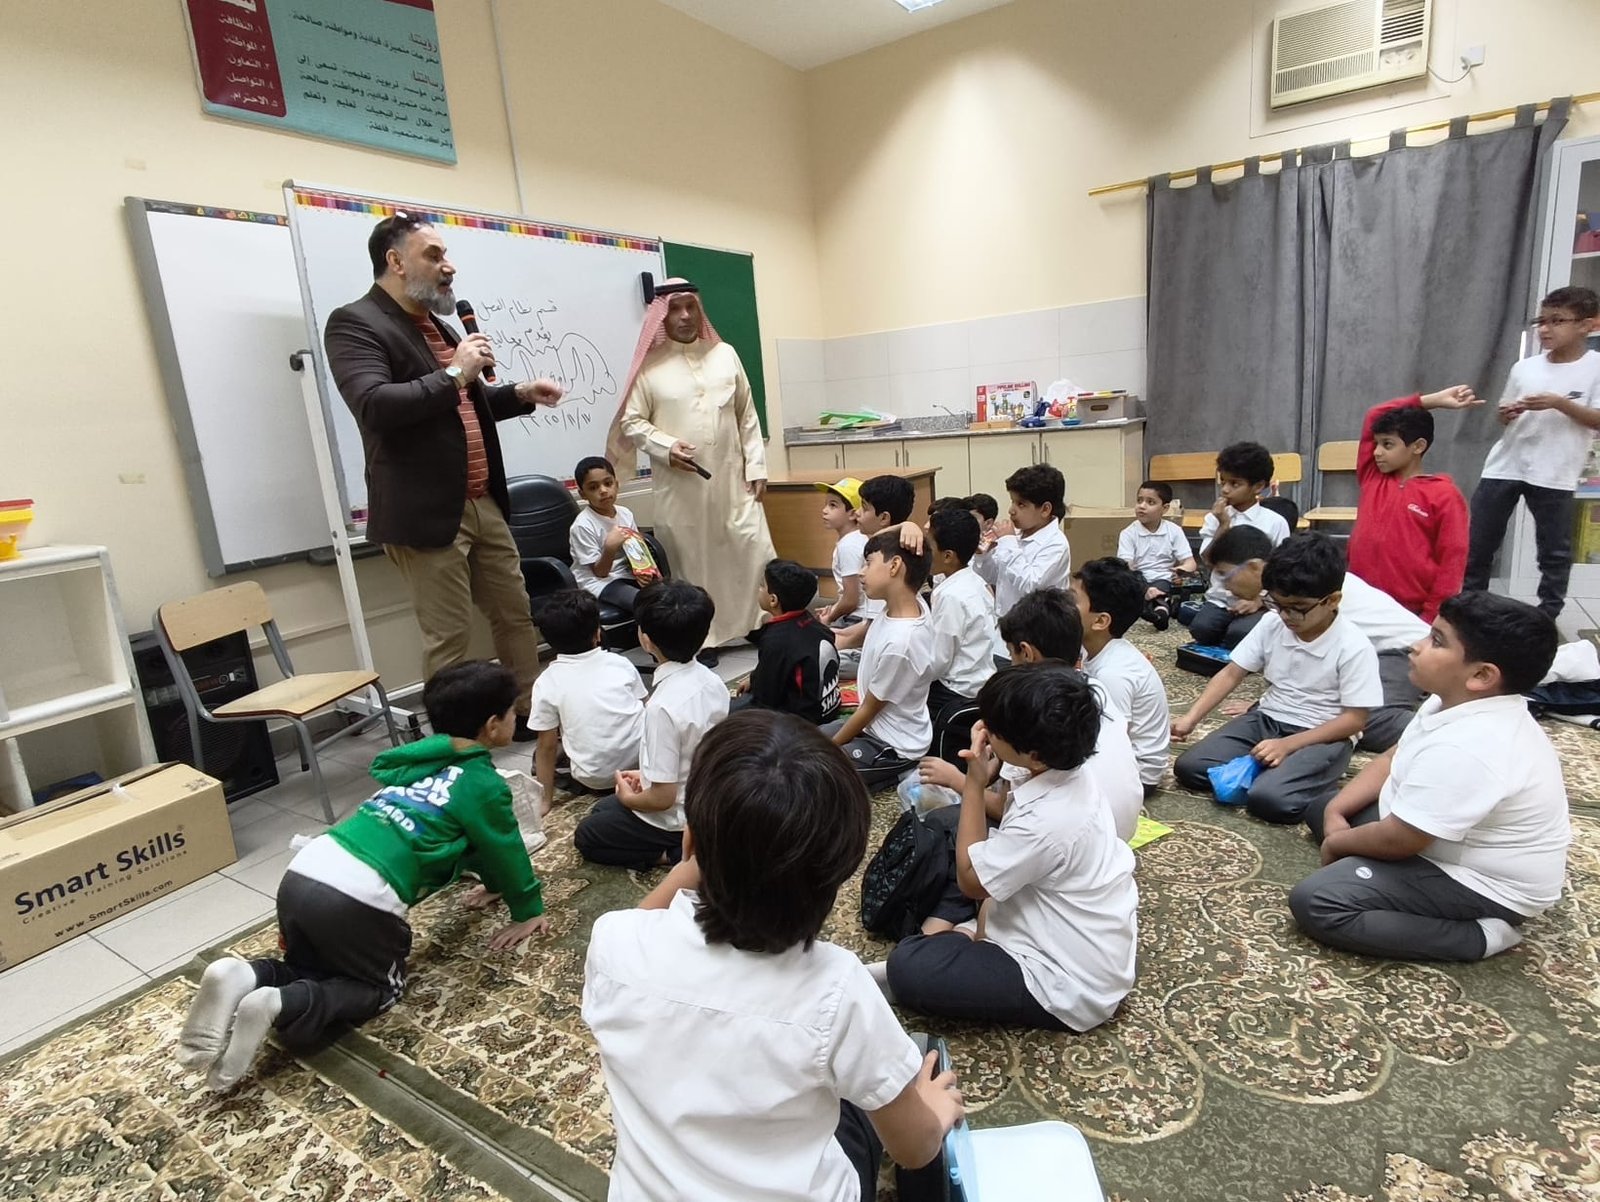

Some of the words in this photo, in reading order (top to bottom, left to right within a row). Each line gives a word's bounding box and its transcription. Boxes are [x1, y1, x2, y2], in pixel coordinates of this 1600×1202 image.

[15, 862, 109, 915] Smart
[116, 832, 186, 872] Skills
[22, 899, 76, 925] Creative
[84, 873, 133, 897] Training
[137, 850, 188, 874] Solutions
[54, 879, 174, 938] www.SmartSkills.com
